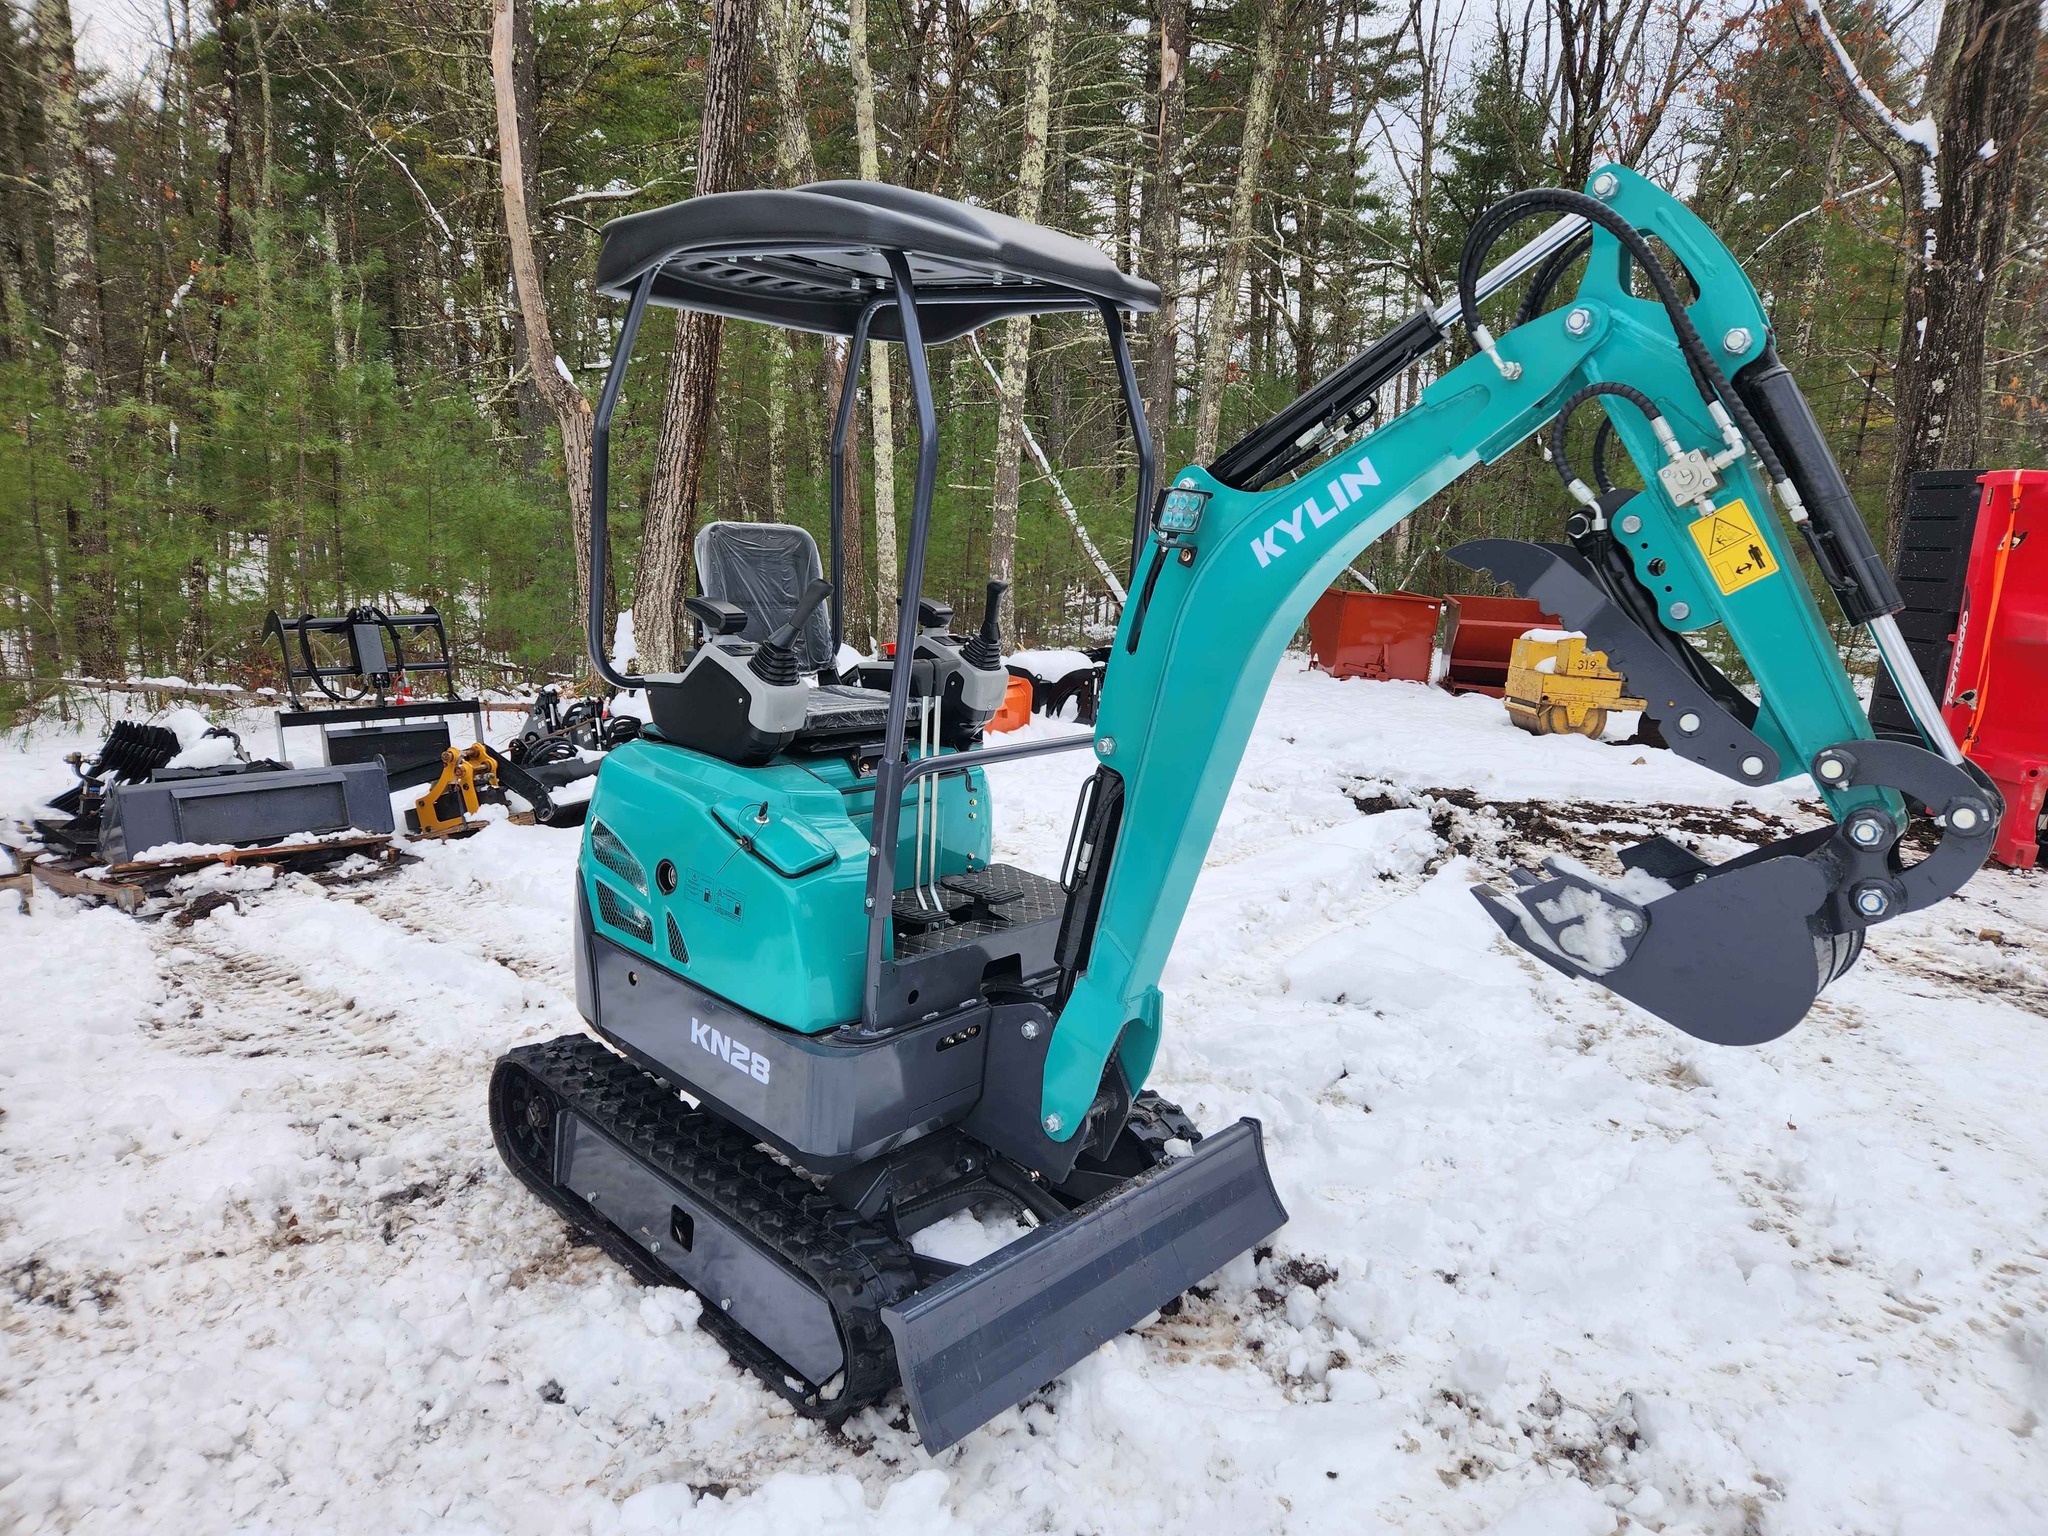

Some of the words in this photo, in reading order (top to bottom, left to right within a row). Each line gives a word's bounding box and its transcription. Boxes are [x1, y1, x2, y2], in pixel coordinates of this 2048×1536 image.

[1250, 455, 1382, 569] KYLIN
[1577, 659, 1597, 671] 319
[1945, 610, 1969, 705] Tornado
[691, 1017, 770, 1085] KN28
